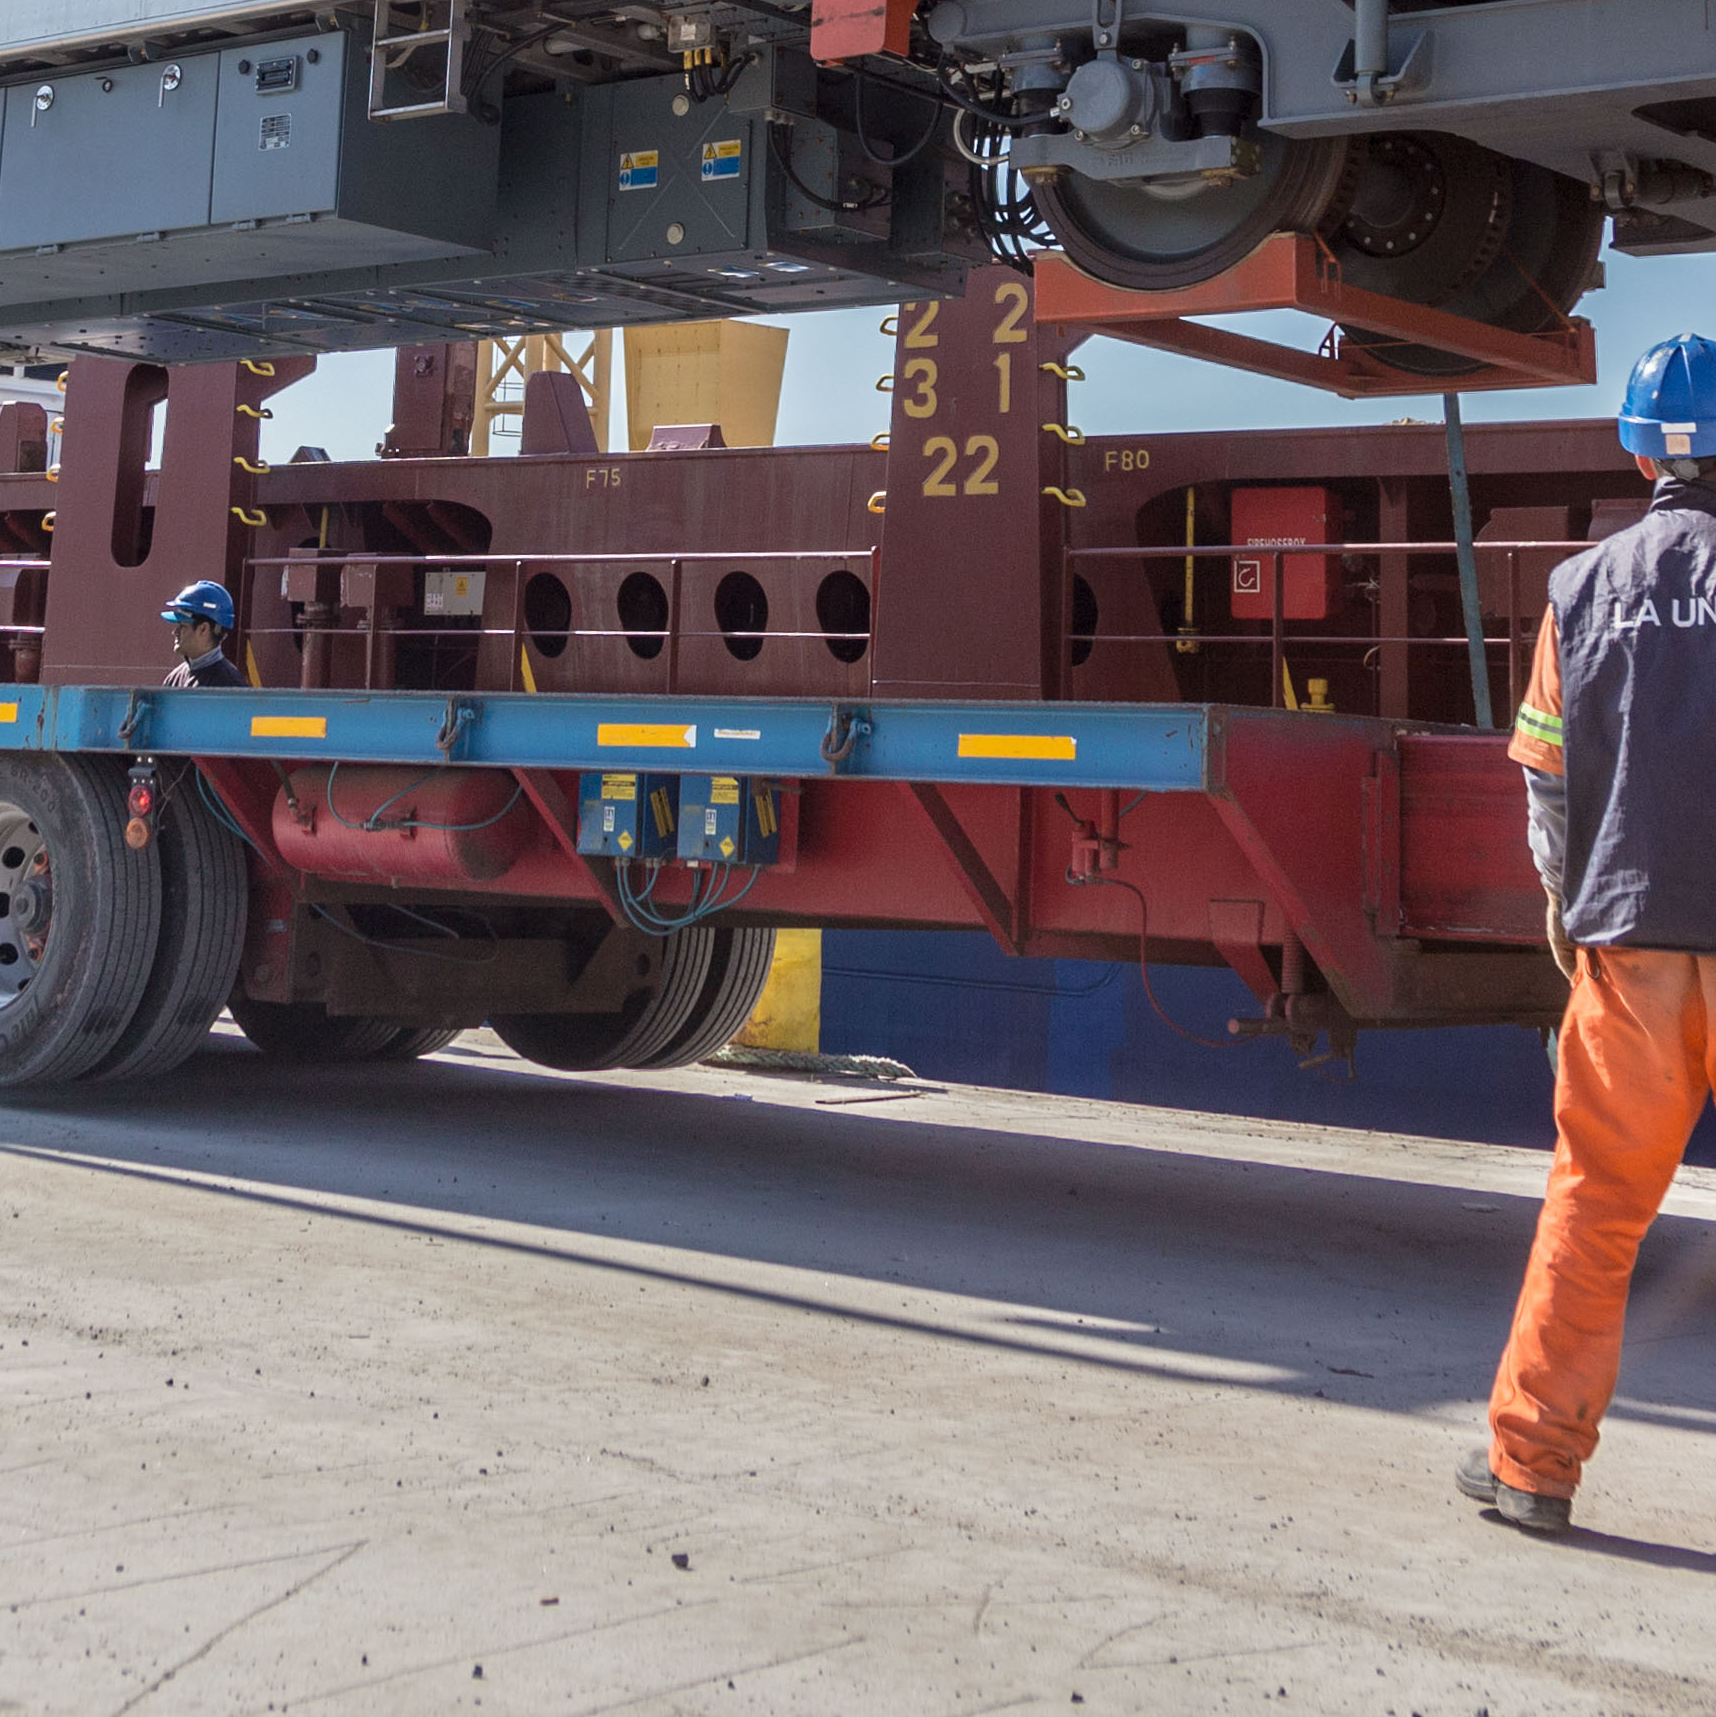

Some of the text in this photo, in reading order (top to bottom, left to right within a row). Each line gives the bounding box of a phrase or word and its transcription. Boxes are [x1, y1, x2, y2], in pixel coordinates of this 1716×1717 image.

[993, 283, 1029, 344] 2
[903, 353, 1012, 419] 3 1
[586, 468, 622, 489] F75
[923, 435, 1000, 497] 22
[1105, 450, 1150, 472] F80
[1614, 599, 1661, 629] LA
